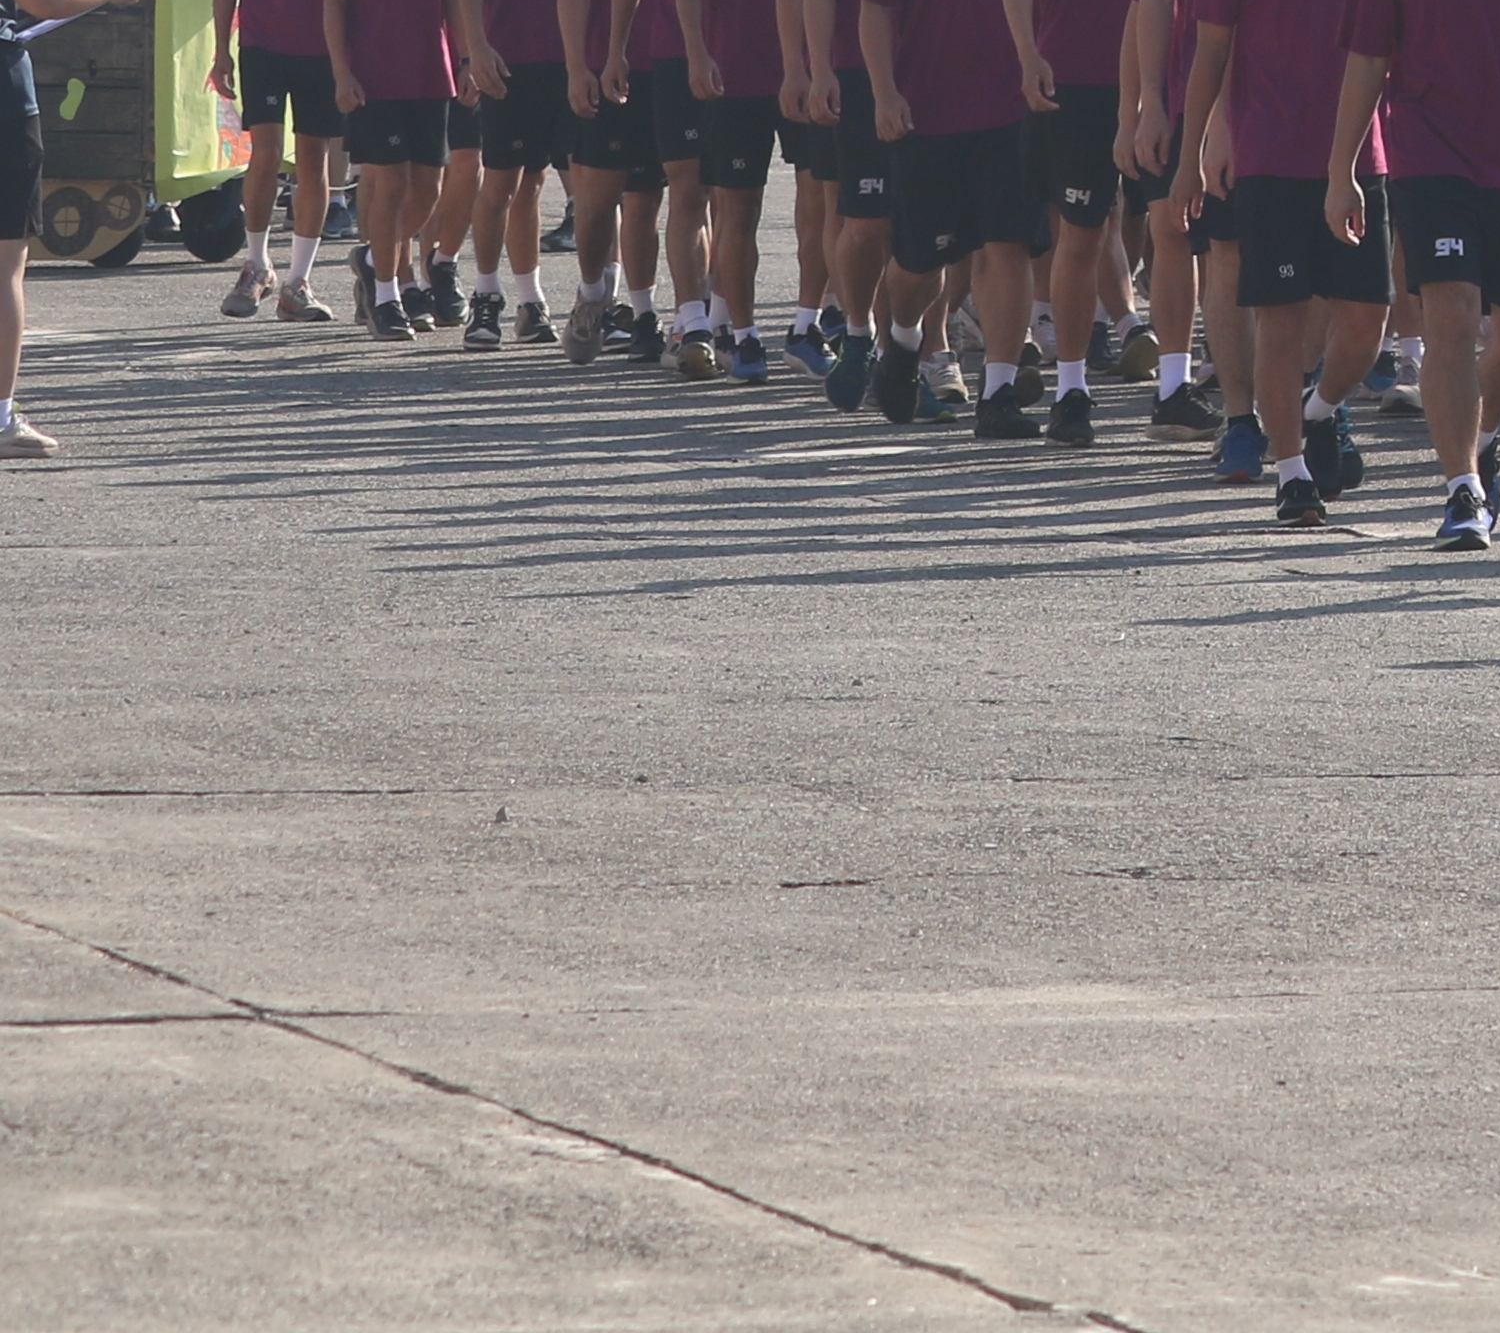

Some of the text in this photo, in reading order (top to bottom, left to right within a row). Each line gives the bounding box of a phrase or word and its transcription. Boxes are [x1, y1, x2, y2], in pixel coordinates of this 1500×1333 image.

[859, 178, 884, 194] 94
[1065, 187, 1091, 206] 94
[1434, 237, 1464, 257] 94
[1279, 264, 1294, 278] 93
